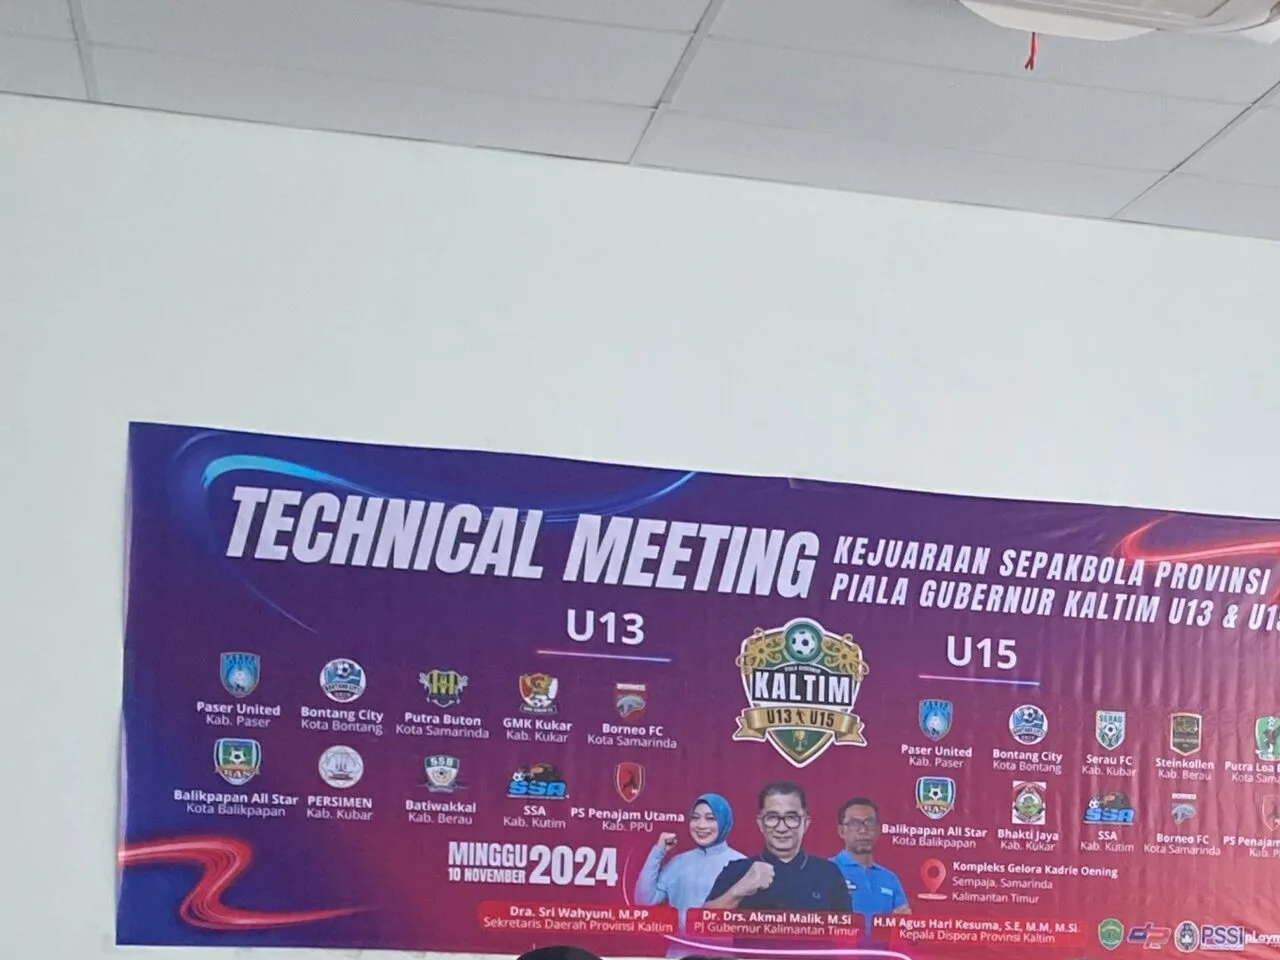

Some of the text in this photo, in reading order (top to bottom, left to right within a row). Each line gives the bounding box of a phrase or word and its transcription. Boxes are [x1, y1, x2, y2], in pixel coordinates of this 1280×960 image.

[226, 486, 819, 599] TECHNICAL MEETING
[833, 535, 1271, 596] KEJUARAAN SEPAKBOLA PROVINSI
[830, 573, 909, 606] PIALA
[919, 580, 1056, 616] GUBERNUR
[1063, 590, 1160, 623] KALTIM
[1168, 598, 1214, 627] U13
[1222, 604, 1239, 629] &
[566, 610, 645, 645] U13
[947, 636, 1018, 671] U15
[754, 671, 850, 703] KALTIM
[197, 702, 280, 716] Paser United
[301, 707, 383, 723] Bontang City
[206, 714, 271, 728] Kab. Paser
[405, 712, 481, 726] Putra Buton
[503, 717, 572, 731] GMK Kukar
[767, 709, 835, 727] U13 U15
[301, 718, 383, 736] Kota Bontang
[396, 724, 489, 739] Kota Samarinda
[602, 723, 664, 736] Borneo FC
[506, 730, 568, 743] Kab. Kukar
[587, 734, 677, 749] Kota Samarinda
[901, 744, 972, 758] Paser United
[993, 749, 1063, 764] Bontang City
[909, 756, 964, 768] Kab. Paser
[1086, 754, 1133, 766] Serau FC
[1155, 758, 1215, 770] Steinkollen
[993, 760, 1062, 775] Kota Bontang
[1082, 766, 1136, 778] Kab. Kubar
[1224, 761, 1253, 773] Putra
[1256, 763, 1274, 774] Loa
[1158, 770, 1212, 782] Kab. Berau
[1231, 774, 1252, 784] Kota
[174, 789, 299, 806] Balikpapan All Star
[307, 796, 373, 808] PERSIMEN
[186, 803, 286, 819] Kota Balikpapan
[405, 800, 477, 813] Batiwakkal
[523, 805, 546, 816] SSA
[306, 809, 373, 821] Kab. Kubar
[408, 813, 473, 826] Kab. Berau
[571, 807, 685, 824] PS Penajam Utama
[503, 816, 567, 829] Kab. Kutim
[602, 820, 653, 832] Kab. PPU
[882, 824, 988, 840] Balikpapan All Star
[997, 829, 1059, 843] Bhakti Jaya
[1098, 830, 1118, 841] SSA
[1156, 833, 1209, 845] Borneo FC
[892, 836, 977, 851] Kota Balikpapan
[1001, 842, 1055, 853] Kab. Kukar
[1081, 842, 1134, 853] Kab. Kutim
[1223, 836, 1236, 846] PS
[1144, 844, 1221, 857] Kota Samarinda
[1249, 849, 1270, 859] Kab.
[448, 841, 618, 887] MINGGU 2024
[953, 862, 1118, 879] Kompleks Gelora Kadrie Oening
[448, 868, 526, 884] 10 NOVEMBER
[952, 878, 1053, 890] Sempaja, Samarinda
[952, 893, 1039, 904] Kalimantan Timur
[510, 905, 649, 922] Dra. Sri Wahyuni, M.PP
[703, 911, 852, 926] Dr. Drs. Akmal Malik, M.Si
[483, 917, 673, 933] Sekretaris Daerah Provinsi Kaltim
[707, 923, 762, 934] Gubernur
[763, 924, 825, 936] Kalimantan
[827, 925, 859, 937] Timur
[873, 917, 896, 928] H.M
[899, 918, 927, 930] Agus
[929, 919, 953, 929] Hari
[956, 920, 1001, 932] Kesuma,
[1005, 921, 1022, 932] S.E,
[1026, 922, 1051, 933] M.M,
[899, 929, 1056, 944] Kepala Dispora Provinsi Kaltim
[1201, 926, 1244, 945] PSSI
